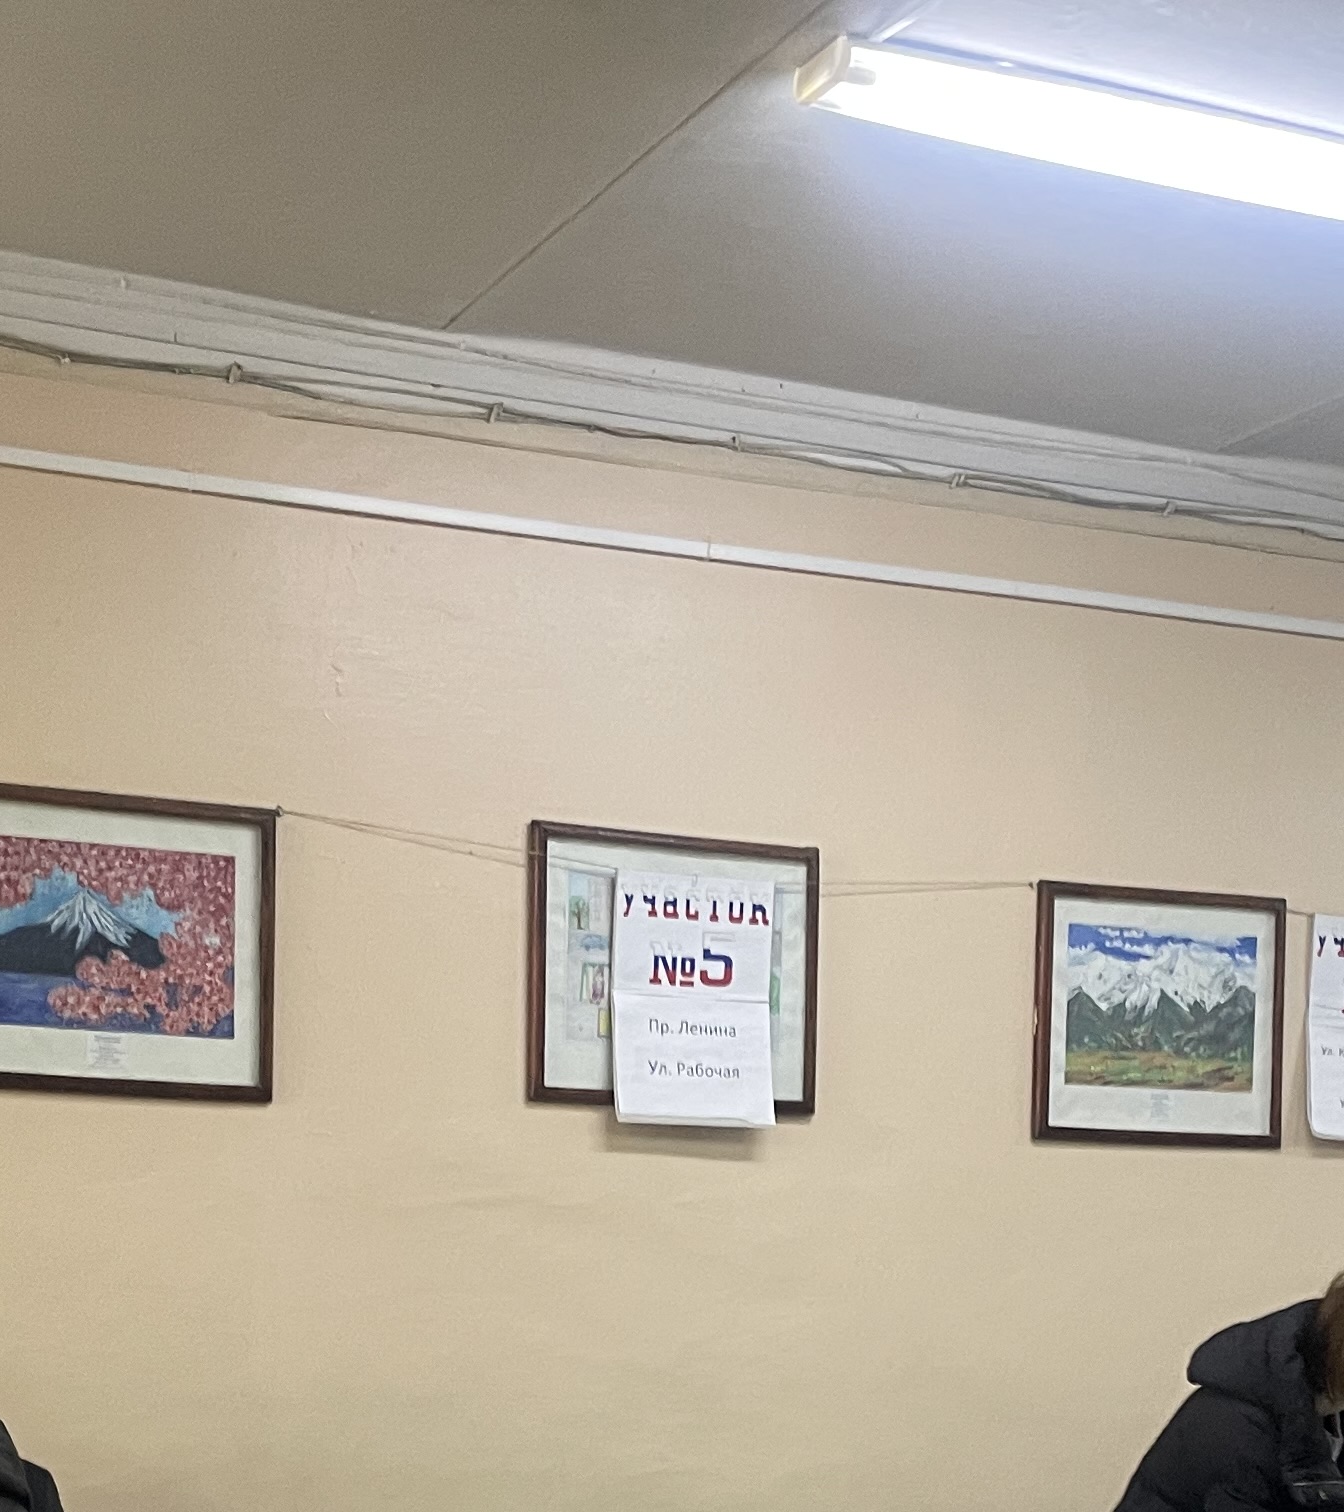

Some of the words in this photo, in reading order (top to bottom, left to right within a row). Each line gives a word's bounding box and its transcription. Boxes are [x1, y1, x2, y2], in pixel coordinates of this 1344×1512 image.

[648, 1017, 674, 1036] Пр.
[678, 1020, 737, 1038] Ленина
[647, 1060, 672, 1076] Ул.
[676, 1062, 740, 1080] Рабочая
